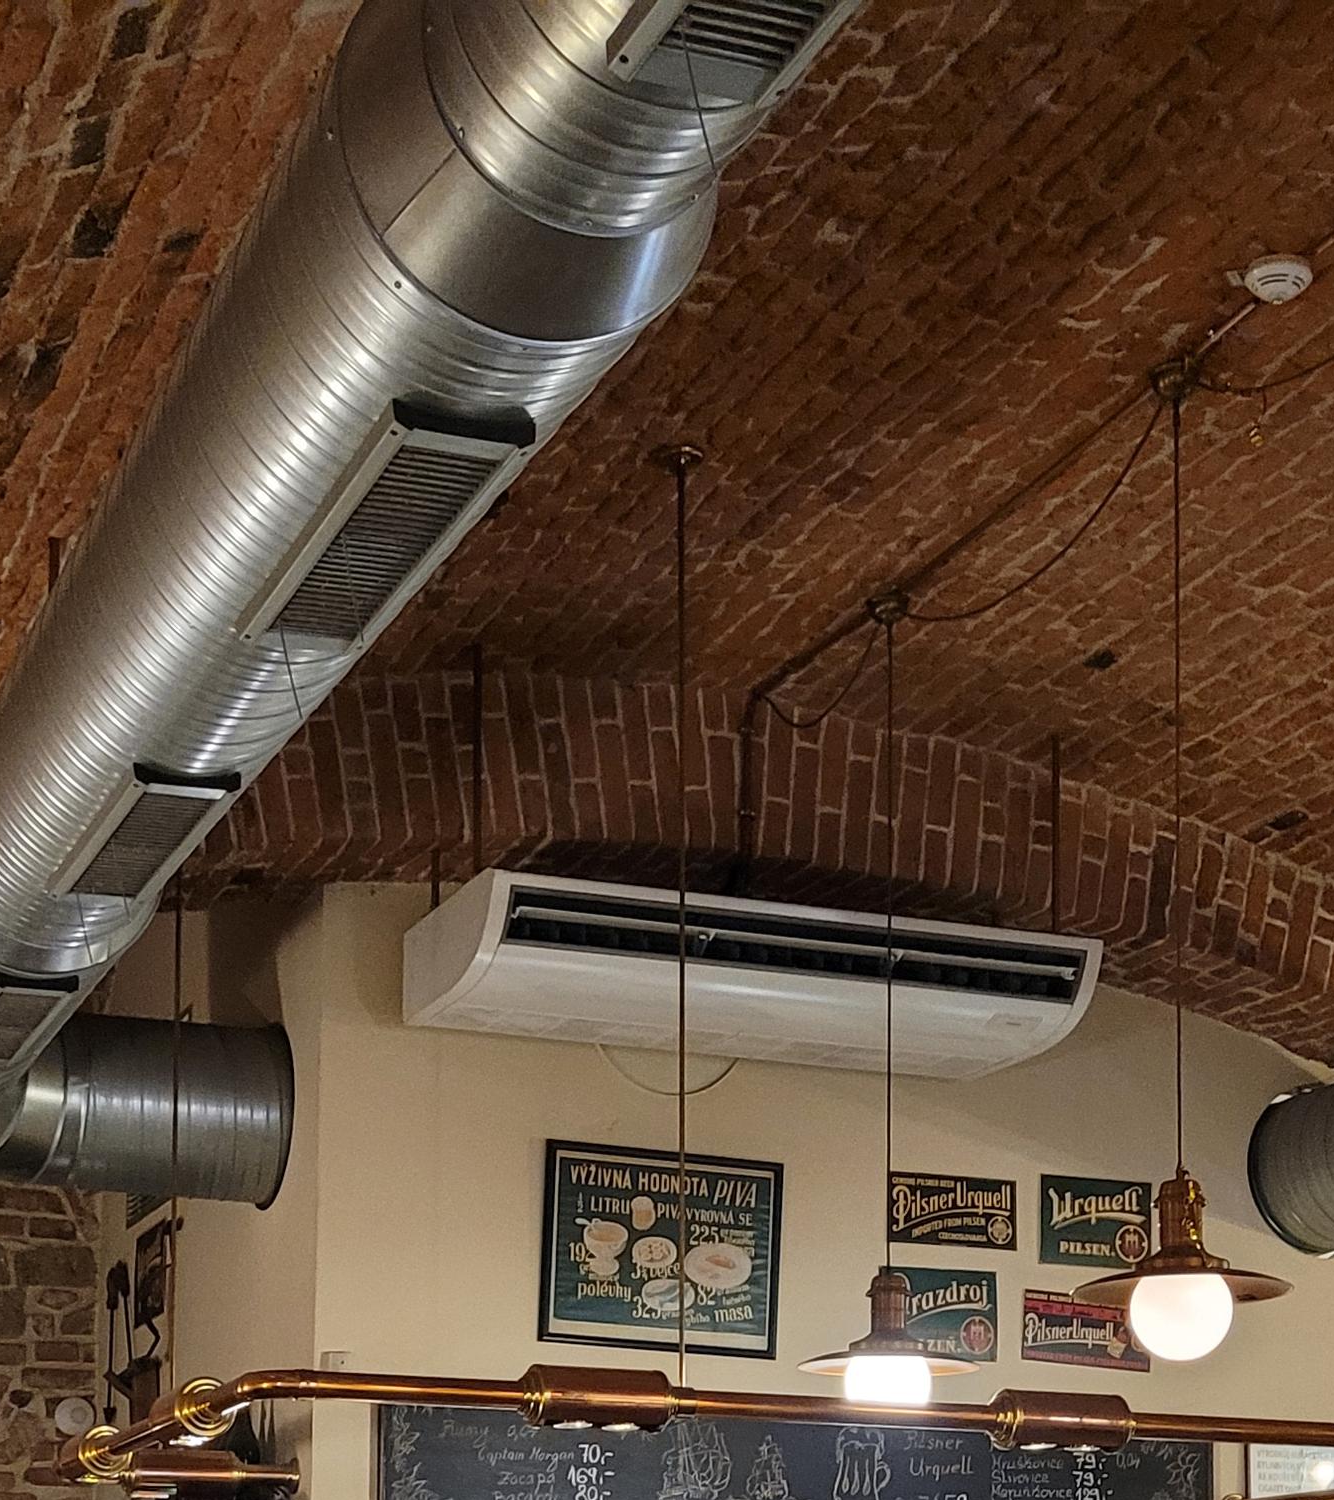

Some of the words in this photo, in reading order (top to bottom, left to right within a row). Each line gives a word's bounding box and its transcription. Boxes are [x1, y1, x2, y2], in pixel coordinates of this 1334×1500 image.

[570, 1163, 633, 1190] VÝŽIVNÁ
[638, 1171, 709, 1198] HODNOTA
[712, 1179, 757, 1208] PIVA
[590, 1195, 631, 1216] LITRU
[656, 1202, 681, 1221] PIV
[738, 1212, 754, 1227] SE
[891, 1184, 955, 1232] Pilsner
[956, 1180, 1011, 1216] Urquell
[1048, 1186, 1143, 1226] Urquell
[689, 1223, 720, 1246] 225
[1059, 1240, 1116, 1257] PILSEN.
[714, 1305, 753, 1323] masa
[1025, 1312, 1073, 1347] Pilsner
[1073, 1318, 1115, 1349] Urquell
[927, 1336, 962, 1354] ZEŇ.
[578, 1443, 614, 1465] 70,-
[909, 1454, 975, 1482] Urquell
